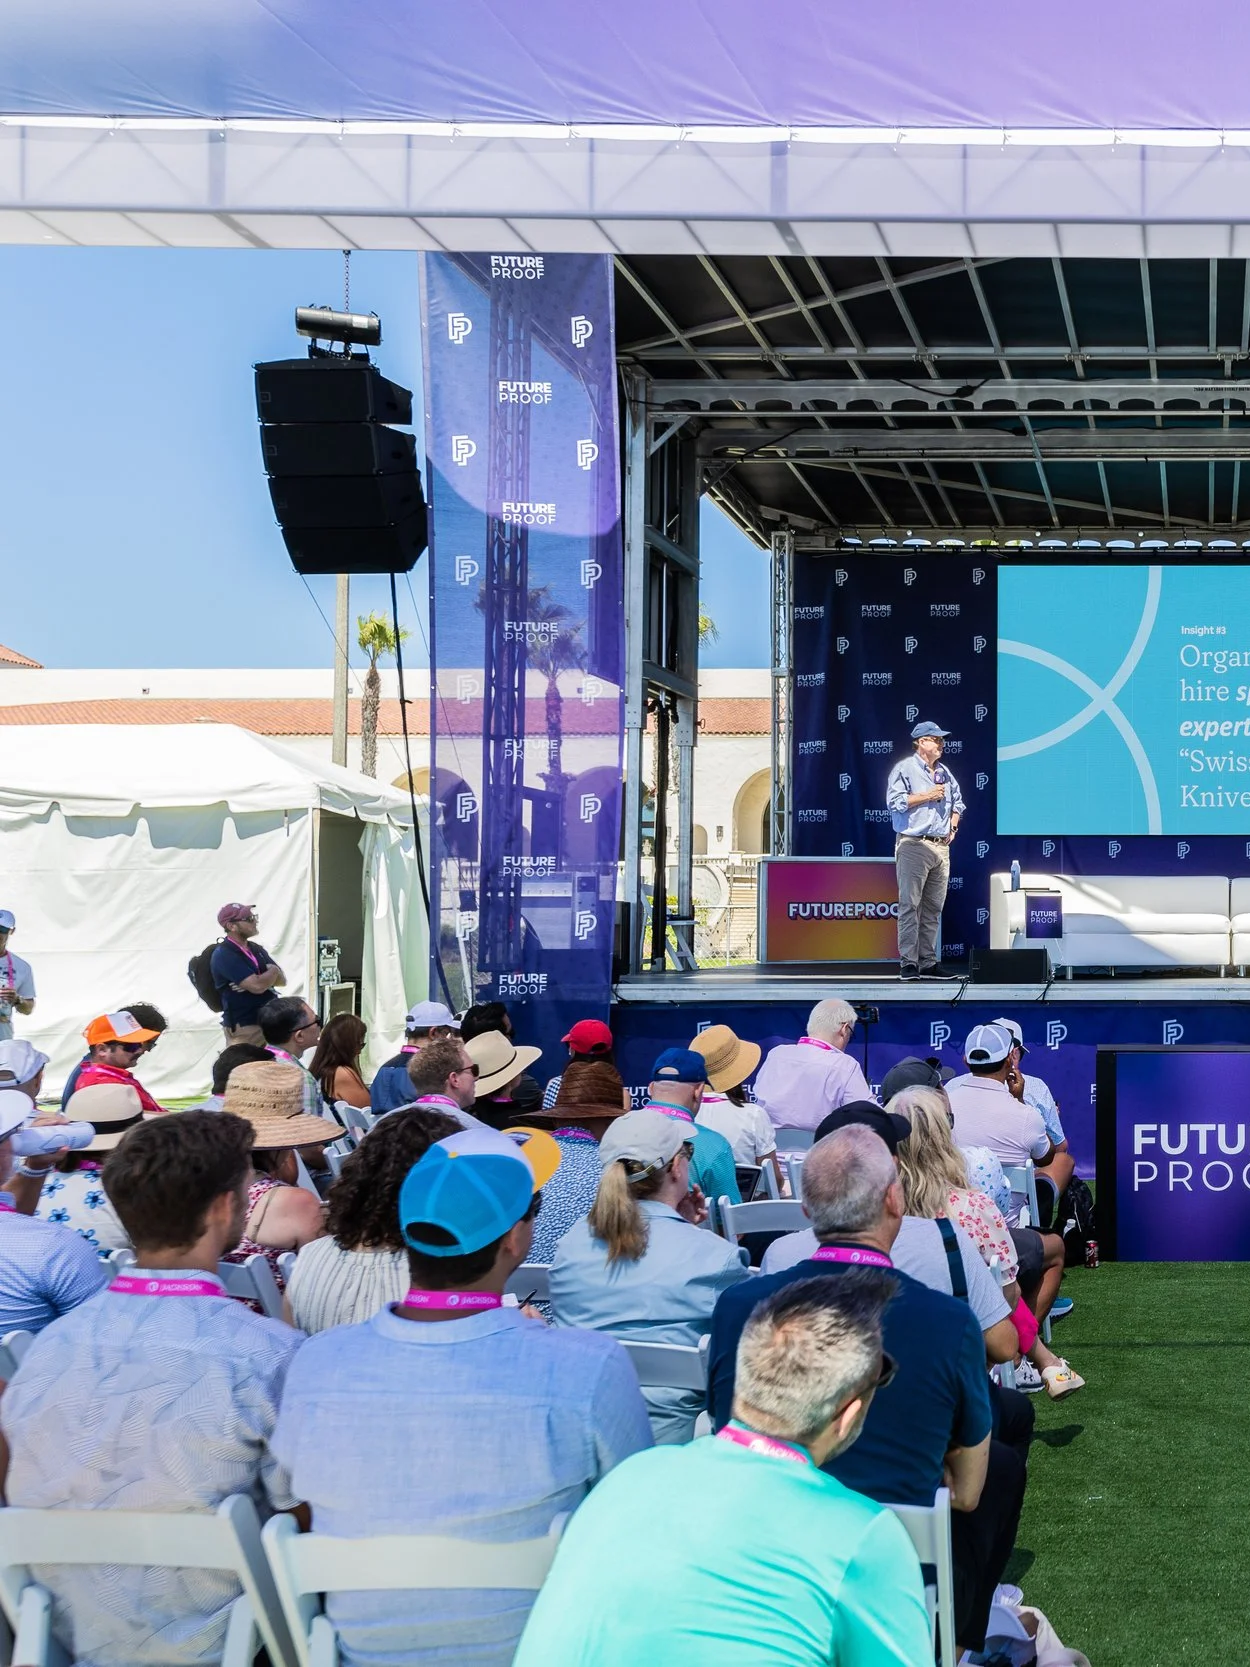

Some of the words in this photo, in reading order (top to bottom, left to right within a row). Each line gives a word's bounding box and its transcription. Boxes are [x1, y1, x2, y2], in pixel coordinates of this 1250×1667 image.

[491, 256, 544, 267] FUTURE
[492, 268, 544, 279] PROOF
[499, 382, 552, 393] FUTURE
[500, 393, 552, 403] PROOF
[503, 502, 556, 513] FUTURE
[503, 514, 556, 524] PROOF
[505, 622, 558, 632] FUTURE
[1182, 626, 1214, 636] Insight
[1216, 626, 1226, 634] #3
[506, 633, 560, 643] PROOF
[1180, 679, 1229, 701] hire
[504, 856, 556, 866] FUTURE
[503, 867, 555, 876] PROOF
[789, 903, 899, 919] FUTUREPROO
[500, 974, 547, 984] FUTURE
[499, 985, 547, 994] PROOF
